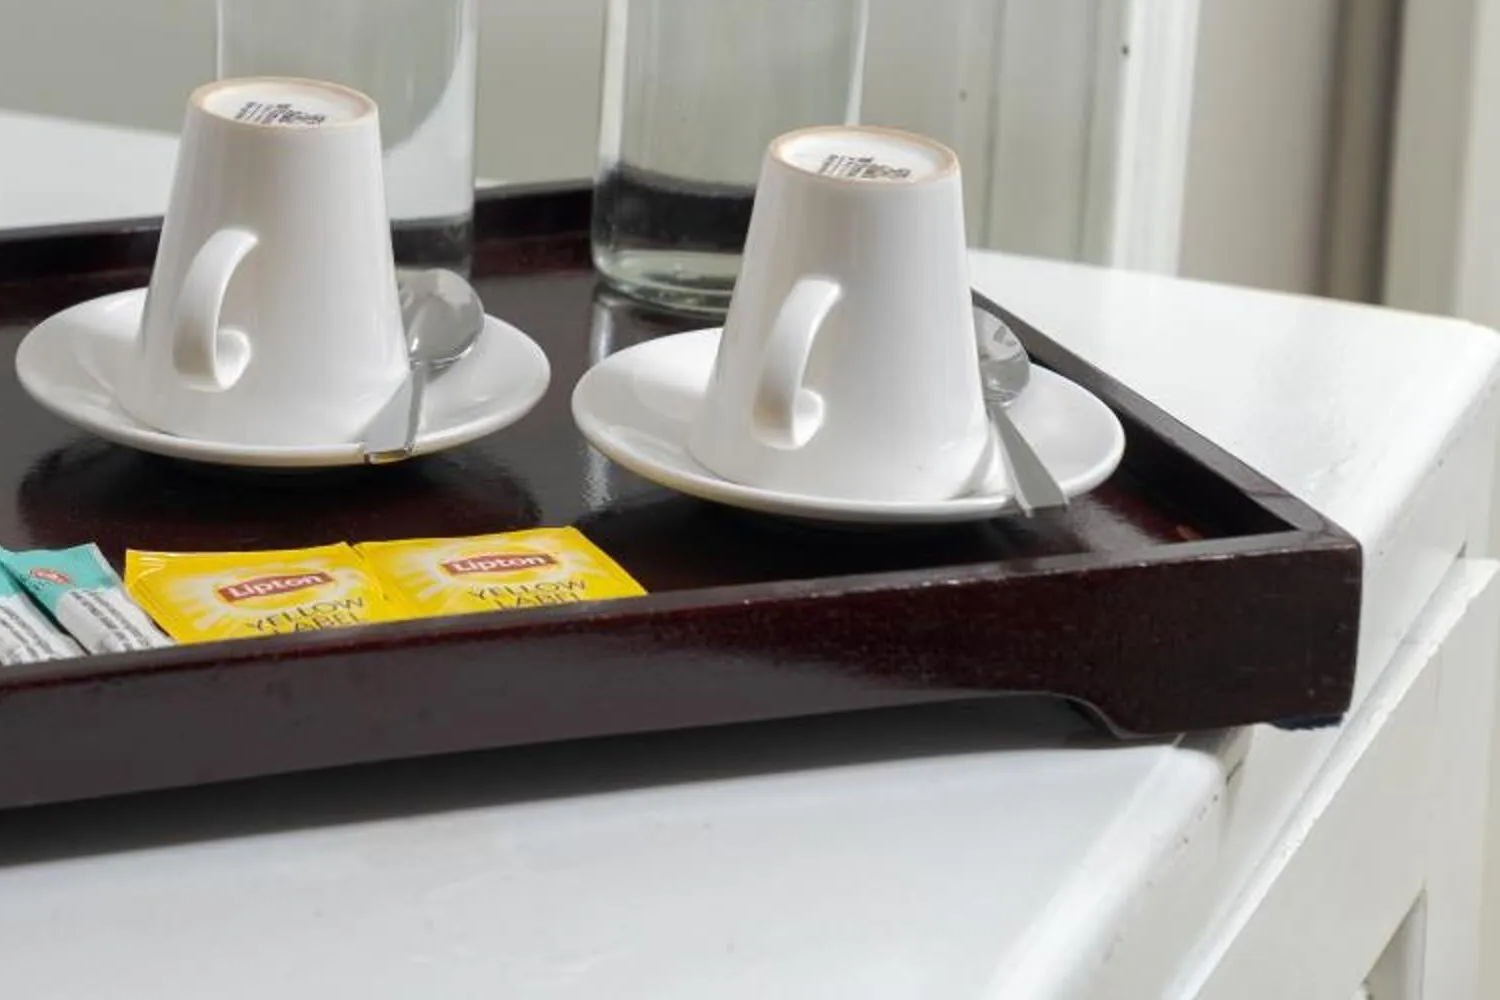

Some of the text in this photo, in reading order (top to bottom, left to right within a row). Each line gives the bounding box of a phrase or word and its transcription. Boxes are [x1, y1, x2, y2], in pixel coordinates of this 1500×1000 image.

[452, 555, 546, 573] Lipton
[228, 573, 324, 599] Lipton
[467, 579, 586, 601] YELLOW
[246, 597, 364, 632] YELLOW
[275, 612, 362, 634] ABEL
